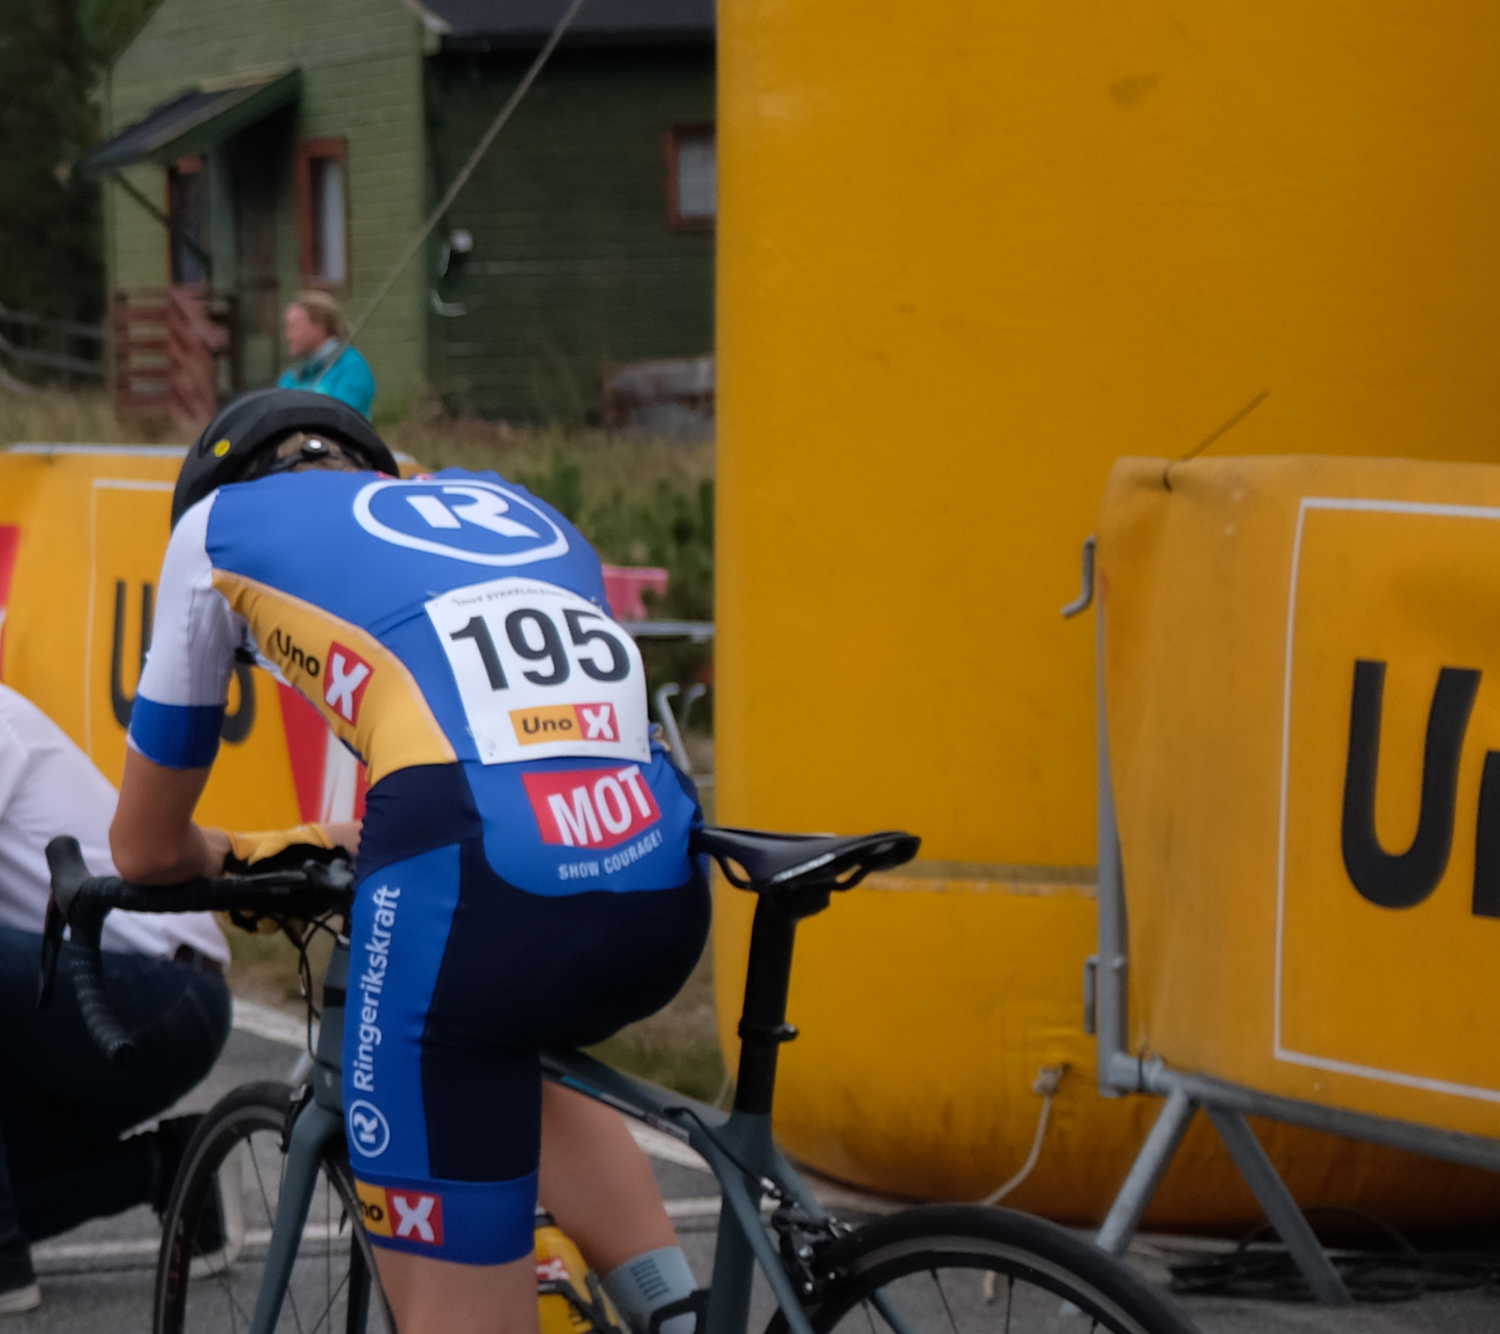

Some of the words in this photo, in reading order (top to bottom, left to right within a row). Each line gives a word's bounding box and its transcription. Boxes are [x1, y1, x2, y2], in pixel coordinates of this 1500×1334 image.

[276, 627, 321, 678] Uno
[325, 652, 371, 721] X
[449, 607, 631, 692] 195
[522, 715, 573, 736] Uno
[582, 704, 615, 740] X
[547, 764, 652, 848] MOT
[558, 862, 600, 881] SHOW
[603, 828, 664, 875] COURAGE!
[353, 884, 401, 1093] Ringerikskraft
[393, 1195, 435, 1243] X
